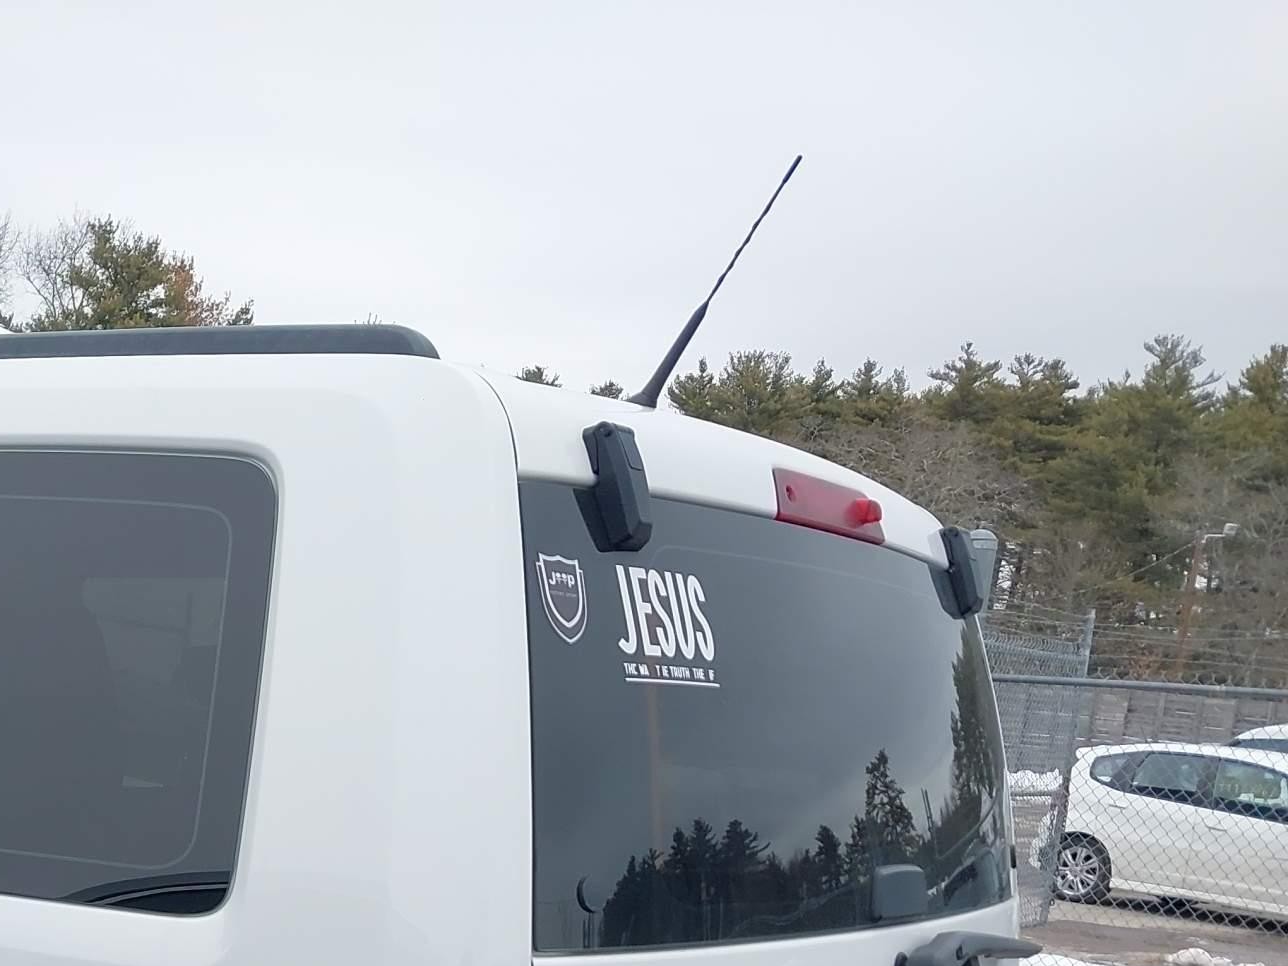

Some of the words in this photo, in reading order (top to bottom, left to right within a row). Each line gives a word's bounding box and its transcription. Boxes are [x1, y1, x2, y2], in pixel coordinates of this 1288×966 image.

[615, 564, 715, 661] JESUS
[638, 663, 650, 676] WA
[669, 665, 691, 679] TRUTH
[692, 667, 706, 680] THE
